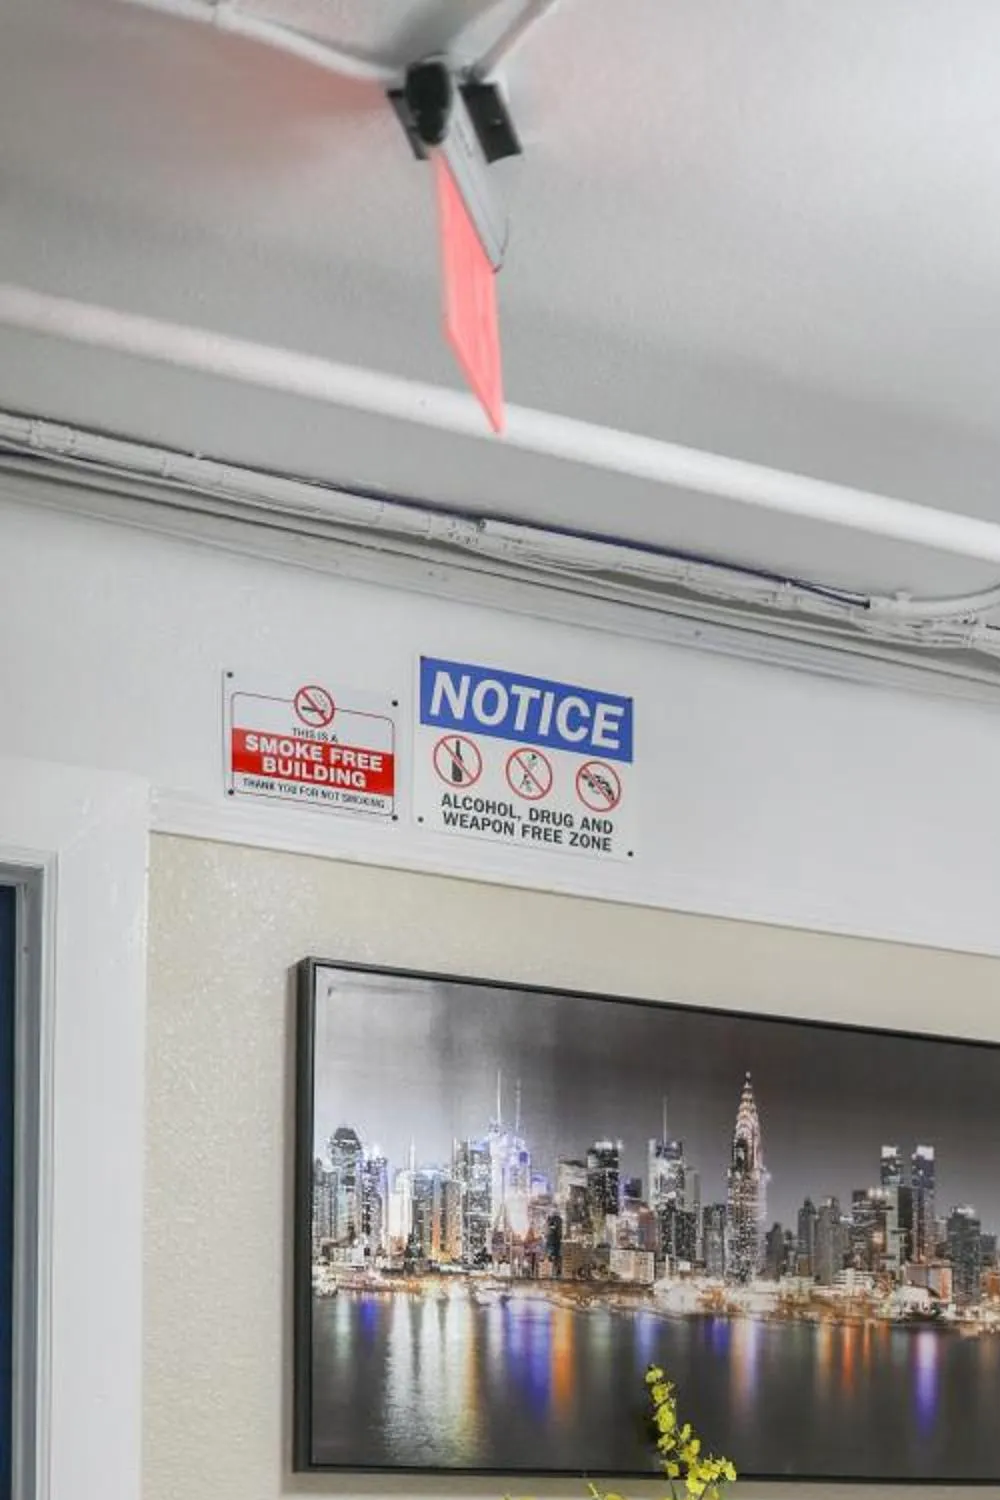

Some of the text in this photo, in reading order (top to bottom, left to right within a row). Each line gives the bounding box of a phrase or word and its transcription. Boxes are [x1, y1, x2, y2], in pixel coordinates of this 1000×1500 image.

[429, 670, 625, 749] NOTICE
[244, 733, 383, 772] SMOKE FREE
[292, 727, 338, 743] THIS IS A
[262, 756, 367, 788] BUILDING
[243, 777, 386, 809] THANK YOU FOR NOT SMOKING
[441, 792, 613, 835] ALCOHOL, DRUG AND
[442, 811, 613, 852] WEAPON FREE ZONE
